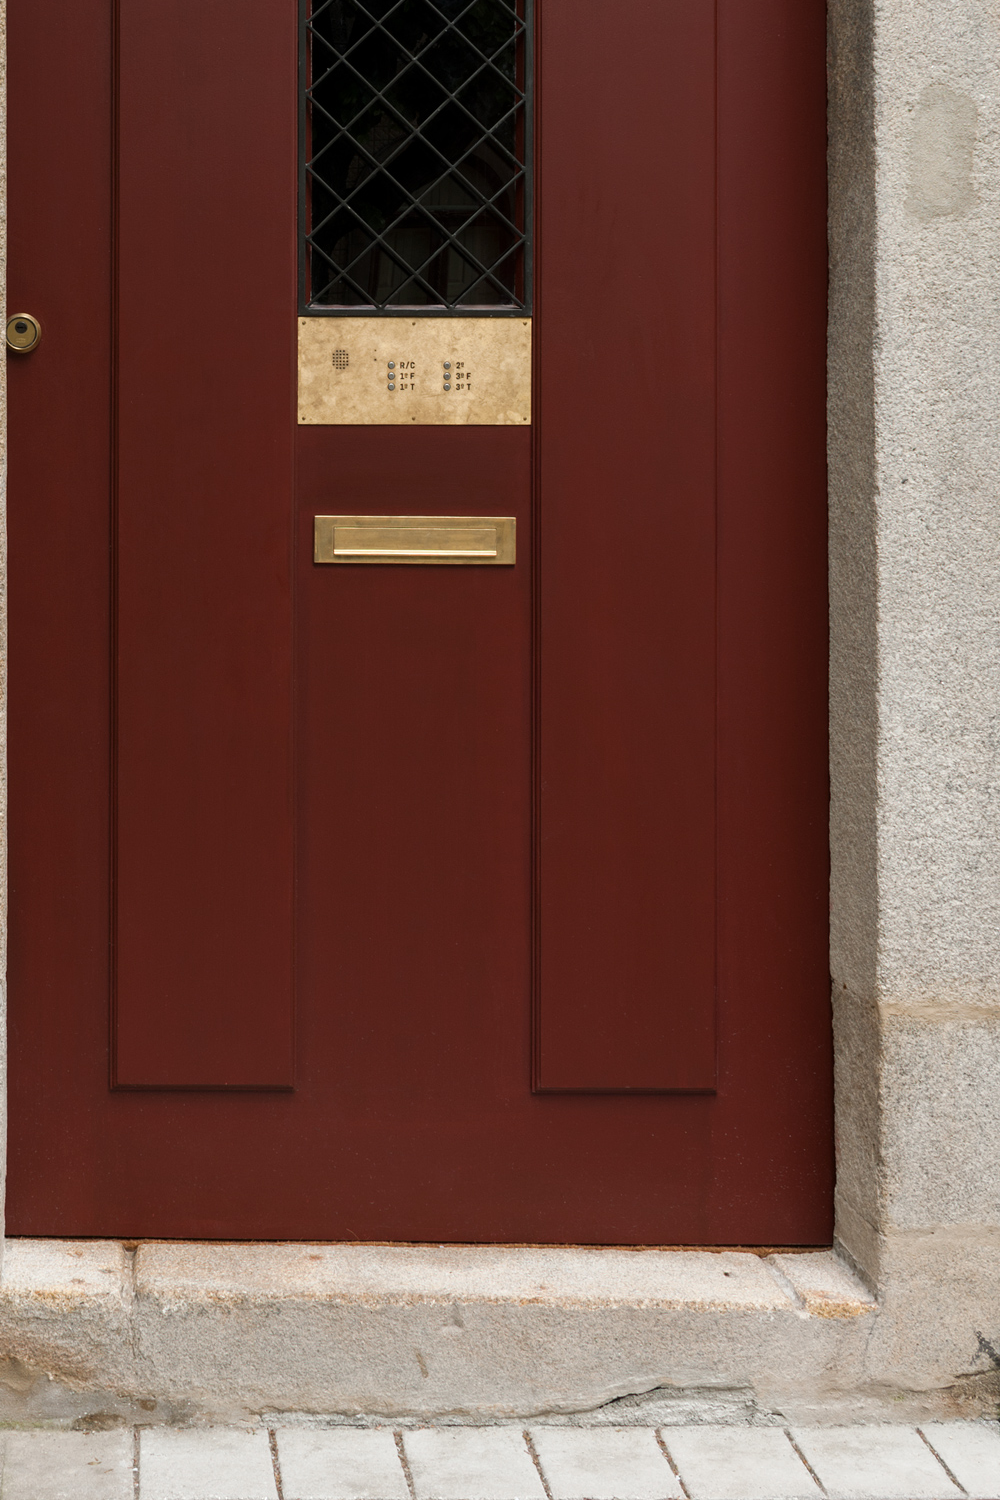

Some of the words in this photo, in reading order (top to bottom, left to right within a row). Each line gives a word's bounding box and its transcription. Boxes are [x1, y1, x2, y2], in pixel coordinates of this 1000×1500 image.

[399, 361, 416, 370] R/C
[409, 372, 416, 380] F
[466, 372, 472, 380] F
[410, 383, 416, 391] T
[466, 383, 472, 391] T
